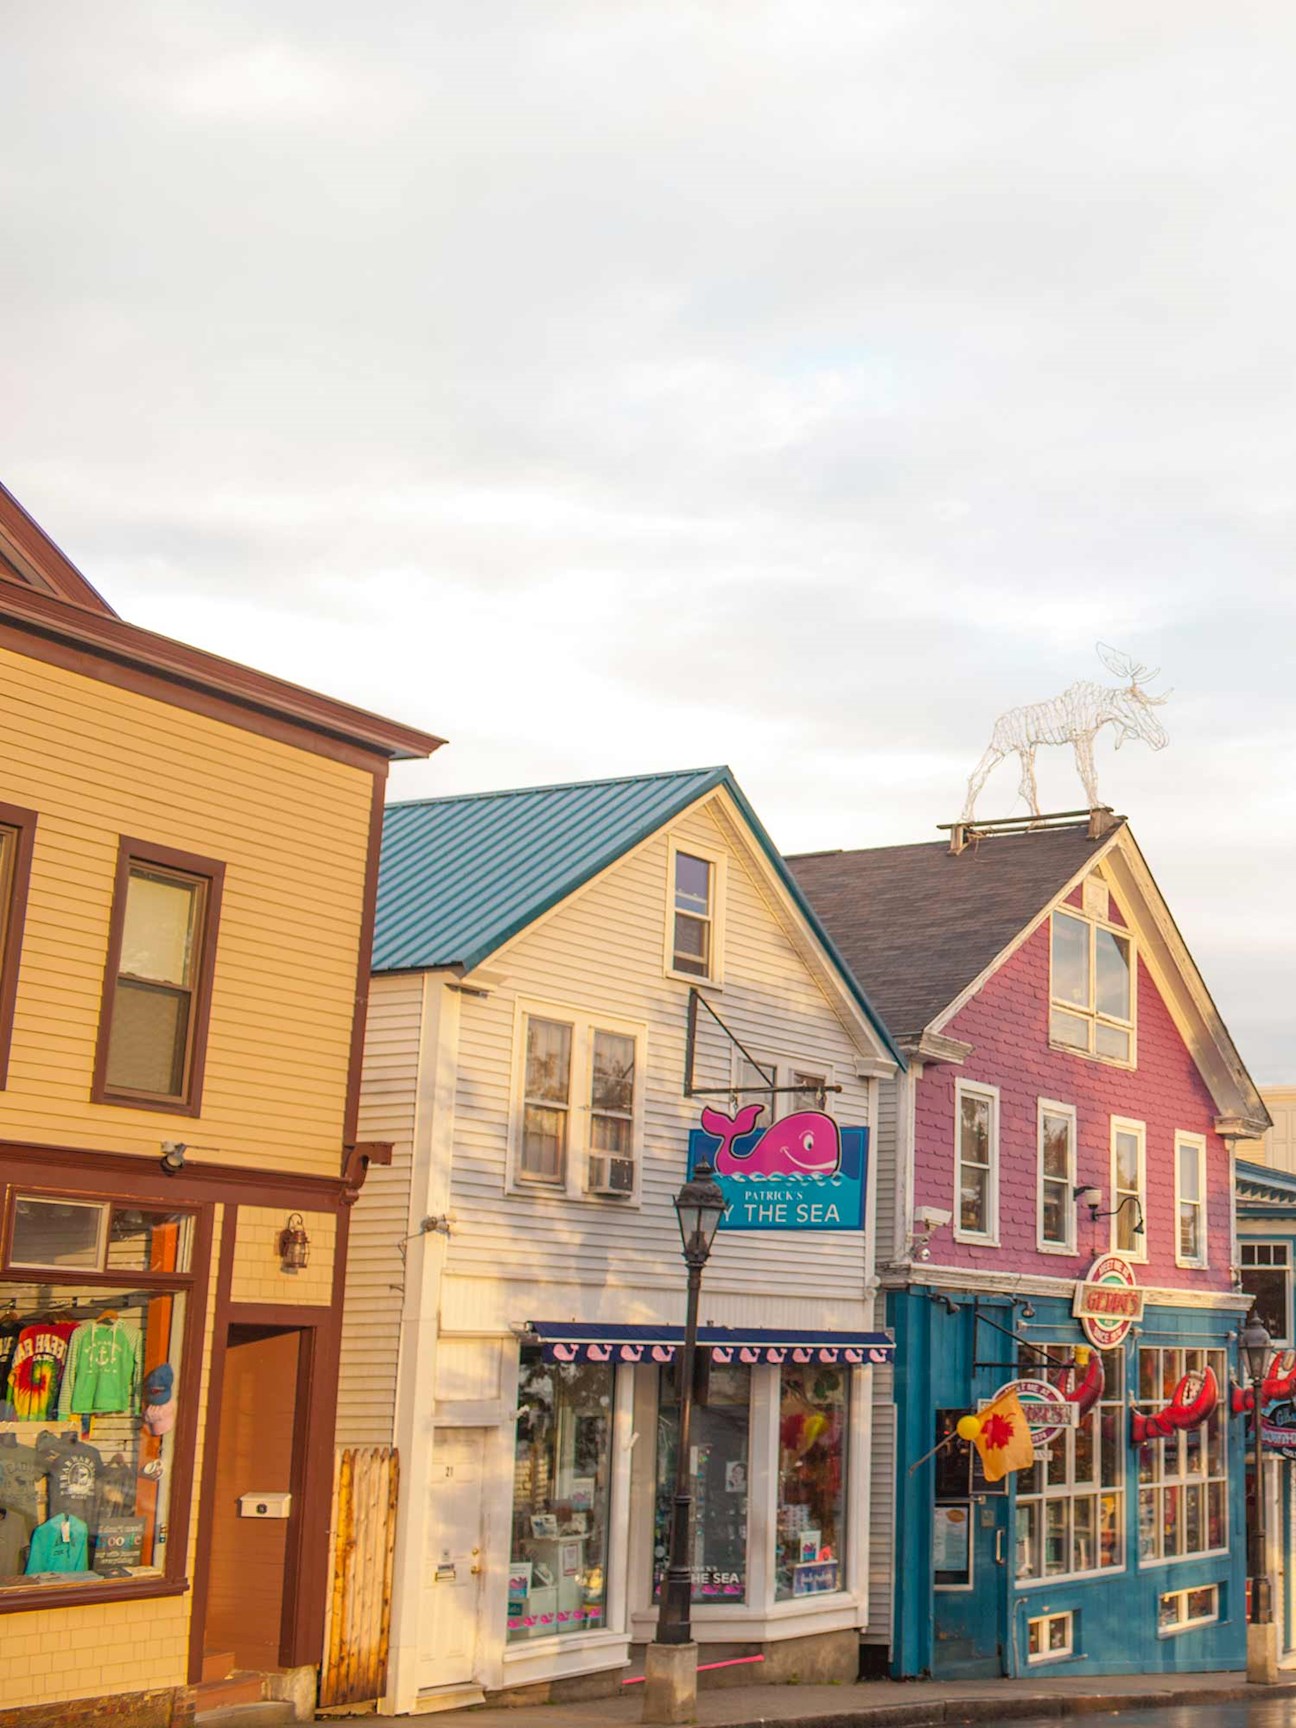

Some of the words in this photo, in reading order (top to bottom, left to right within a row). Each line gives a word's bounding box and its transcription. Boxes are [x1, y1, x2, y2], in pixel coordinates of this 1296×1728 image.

[744, 1190, 803, 1201] PATRICK'S
[744, 1204, 787, 1222] THE
[796, 1203, 840, 1222] SEA
[690, 1573, 709, 1584] HE
[713, 1572, 740, 1584] SEA
